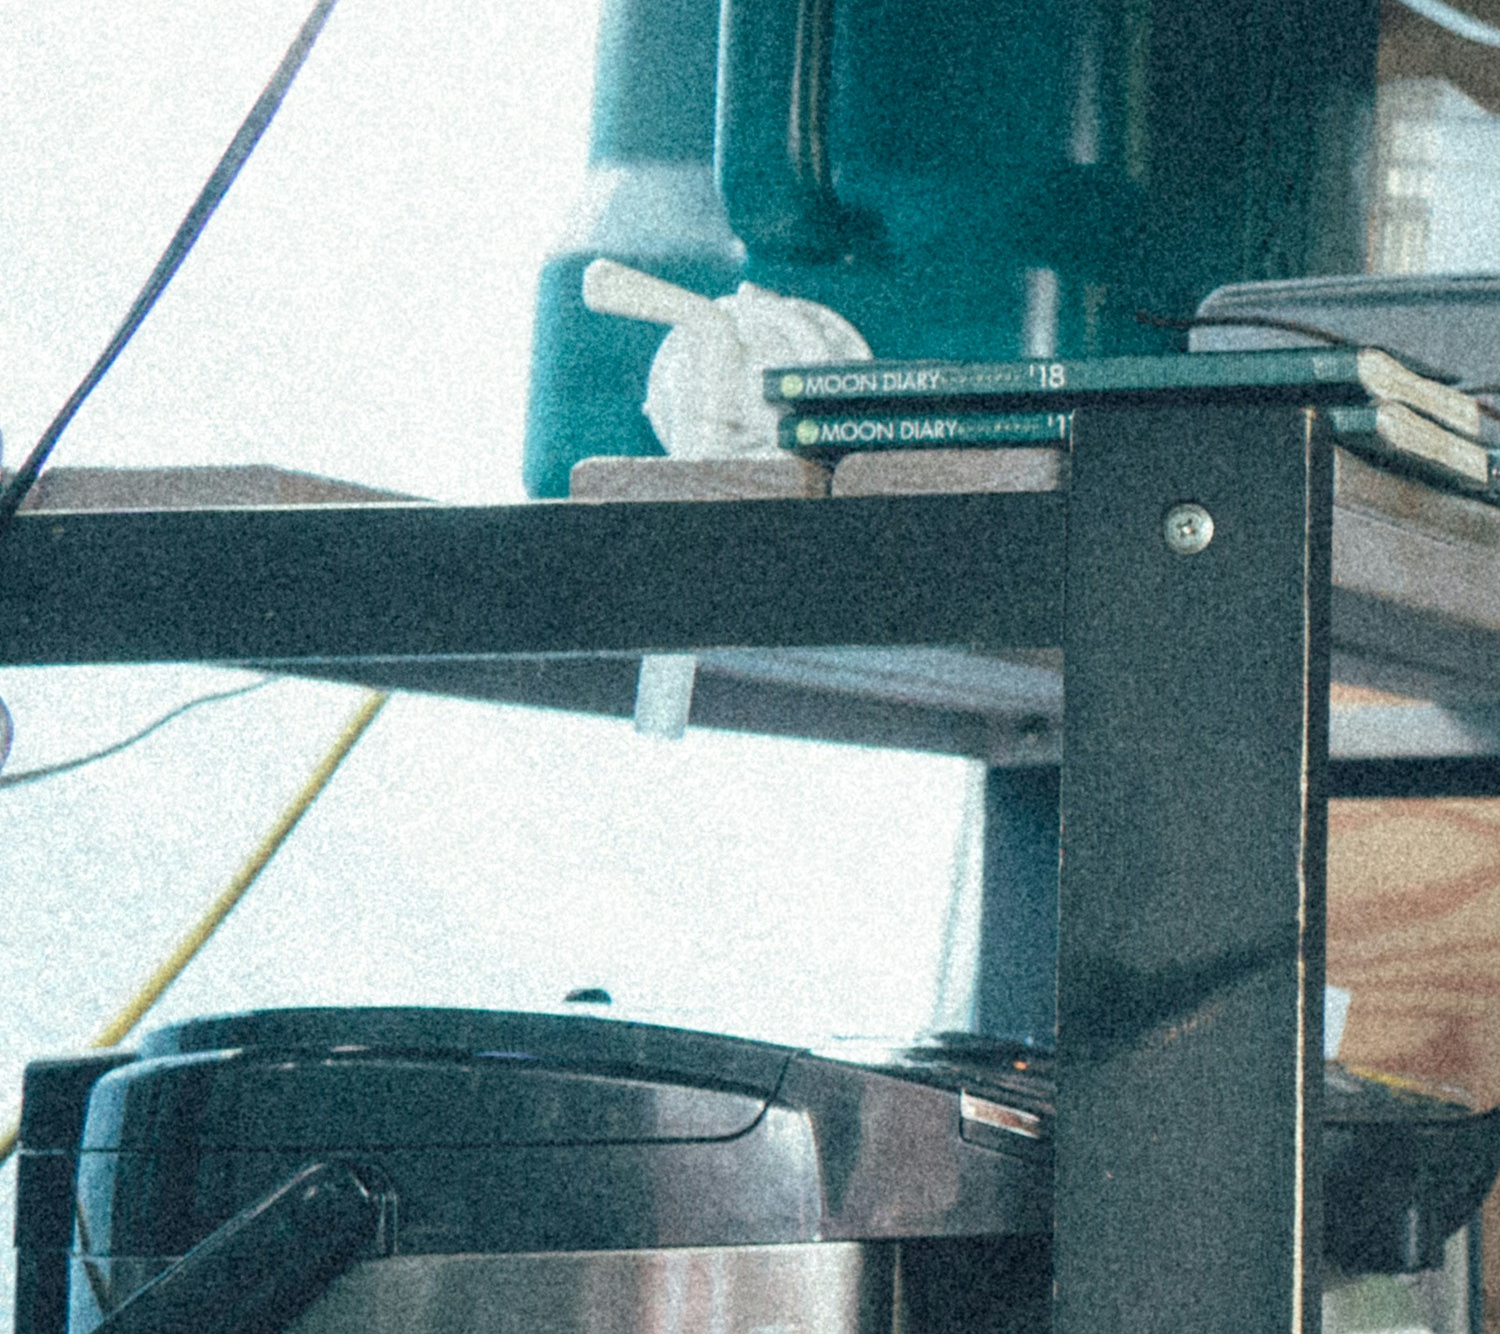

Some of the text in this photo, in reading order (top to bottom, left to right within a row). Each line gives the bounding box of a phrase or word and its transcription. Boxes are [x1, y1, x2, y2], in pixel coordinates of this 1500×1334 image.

[805, 373, 877, 395] MOON
[883, 370, 940, 392] DIARY
[1029, 364, 1065, 388] '18
[821, 420, 894, 442] MOON
[901, 419, 959, 440] DIARY
[1048, 414, 1074, 439] '1
